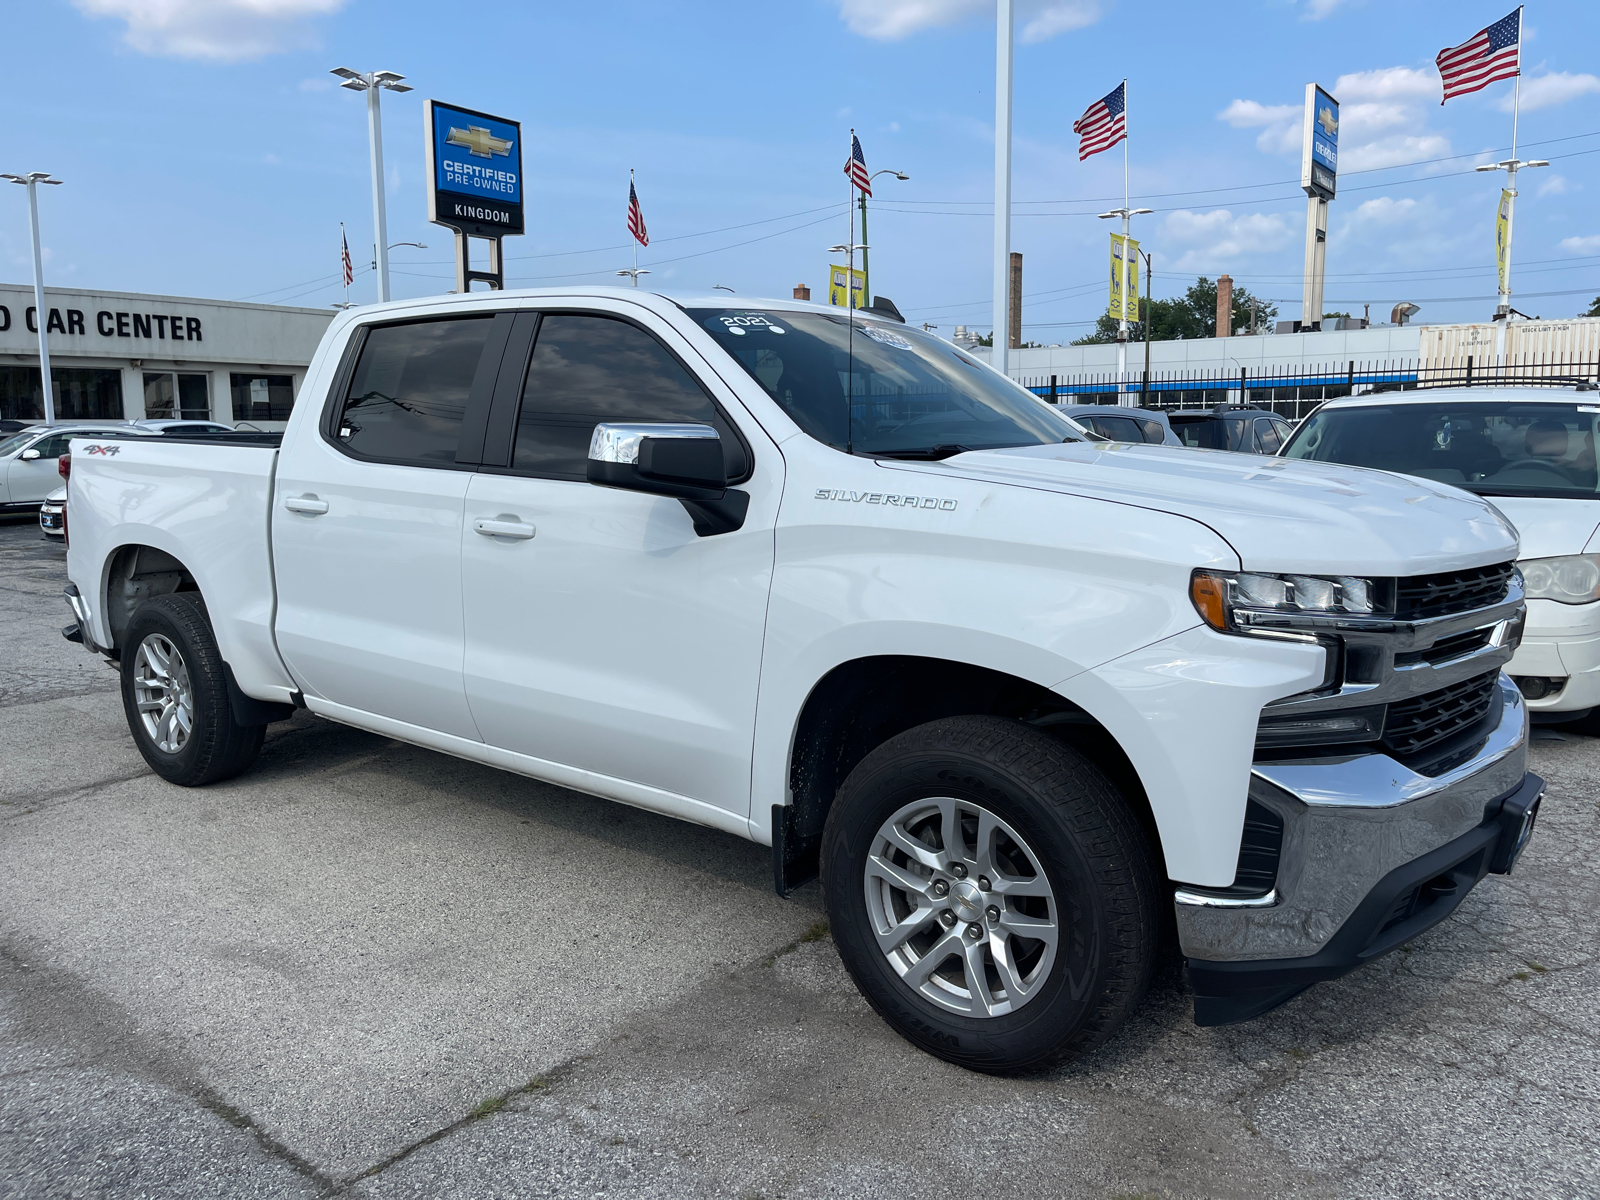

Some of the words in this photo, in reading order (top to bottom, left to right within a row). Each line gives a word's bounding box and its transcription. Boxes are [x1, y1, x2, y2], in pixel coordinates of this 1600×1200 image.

[1315, 141, 1337, 164] CHEVROLET
[443, 160, 516, 184] CERTIFIED
[447, 172, 514, 193] PRE-OWNED
[455, 203, 510, 223] KINGDOM
[25, 306, 85, 335] CAR
[97, 311, 202, 341] CENTER
[719, 315, 774, 327] 2021
[814, 488, 958, 511] SILVERADO
[935, 766, 1087, 959] GOODYEAR
